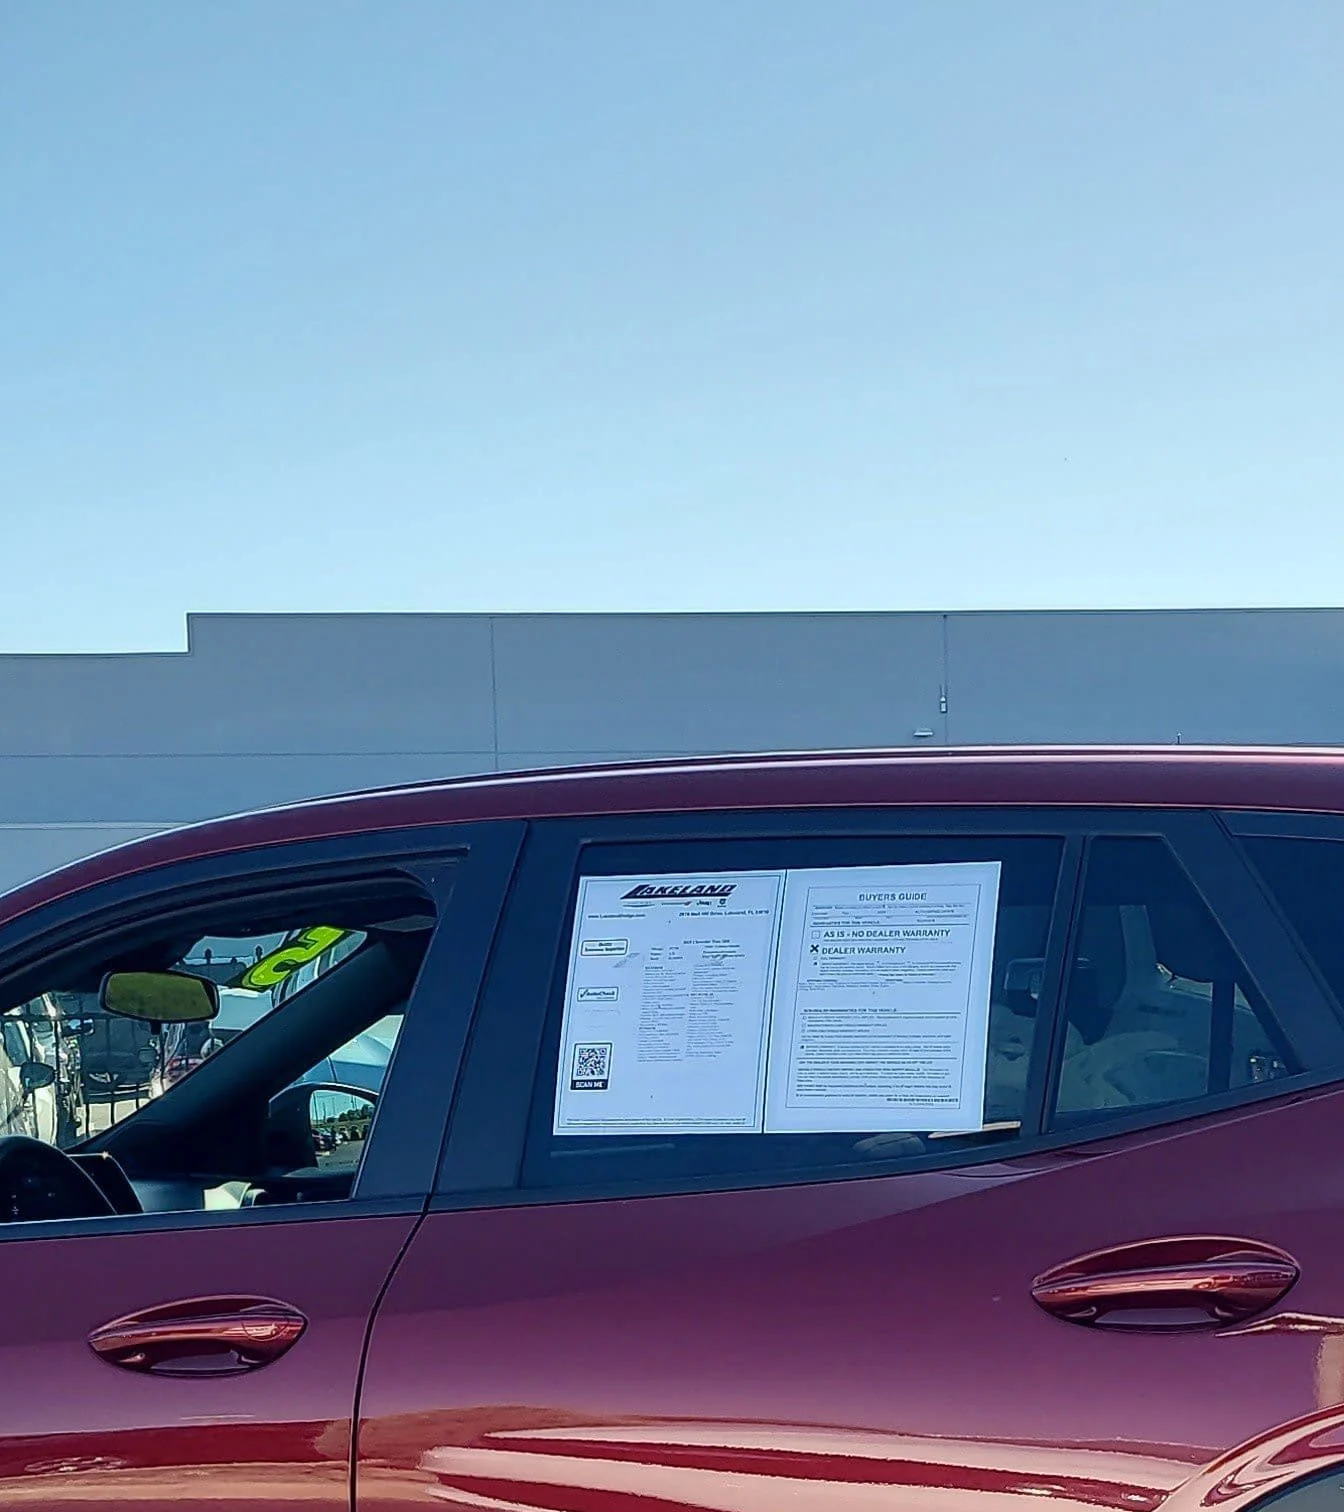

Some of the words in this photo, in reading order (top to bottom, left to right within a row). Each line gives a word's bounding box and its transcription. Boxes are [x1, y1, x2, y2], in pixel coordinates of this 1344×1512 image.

[621, 884, 738, 900] LAKELAND
[858, 893, 896, 901] BUYERS
[898, 892, 927, 901] GUIDE
[823, 930, 835, 938] AS
[837, 930, 845, 938] IS
[851, 930, 864, 938] NO
[866, 929, 901, 938] DEALER
[902, 929, 951, 937] WARRANTY
[821, 947, 856, 955] DEALER
[857, 946, 906, 954] WARRANTY
